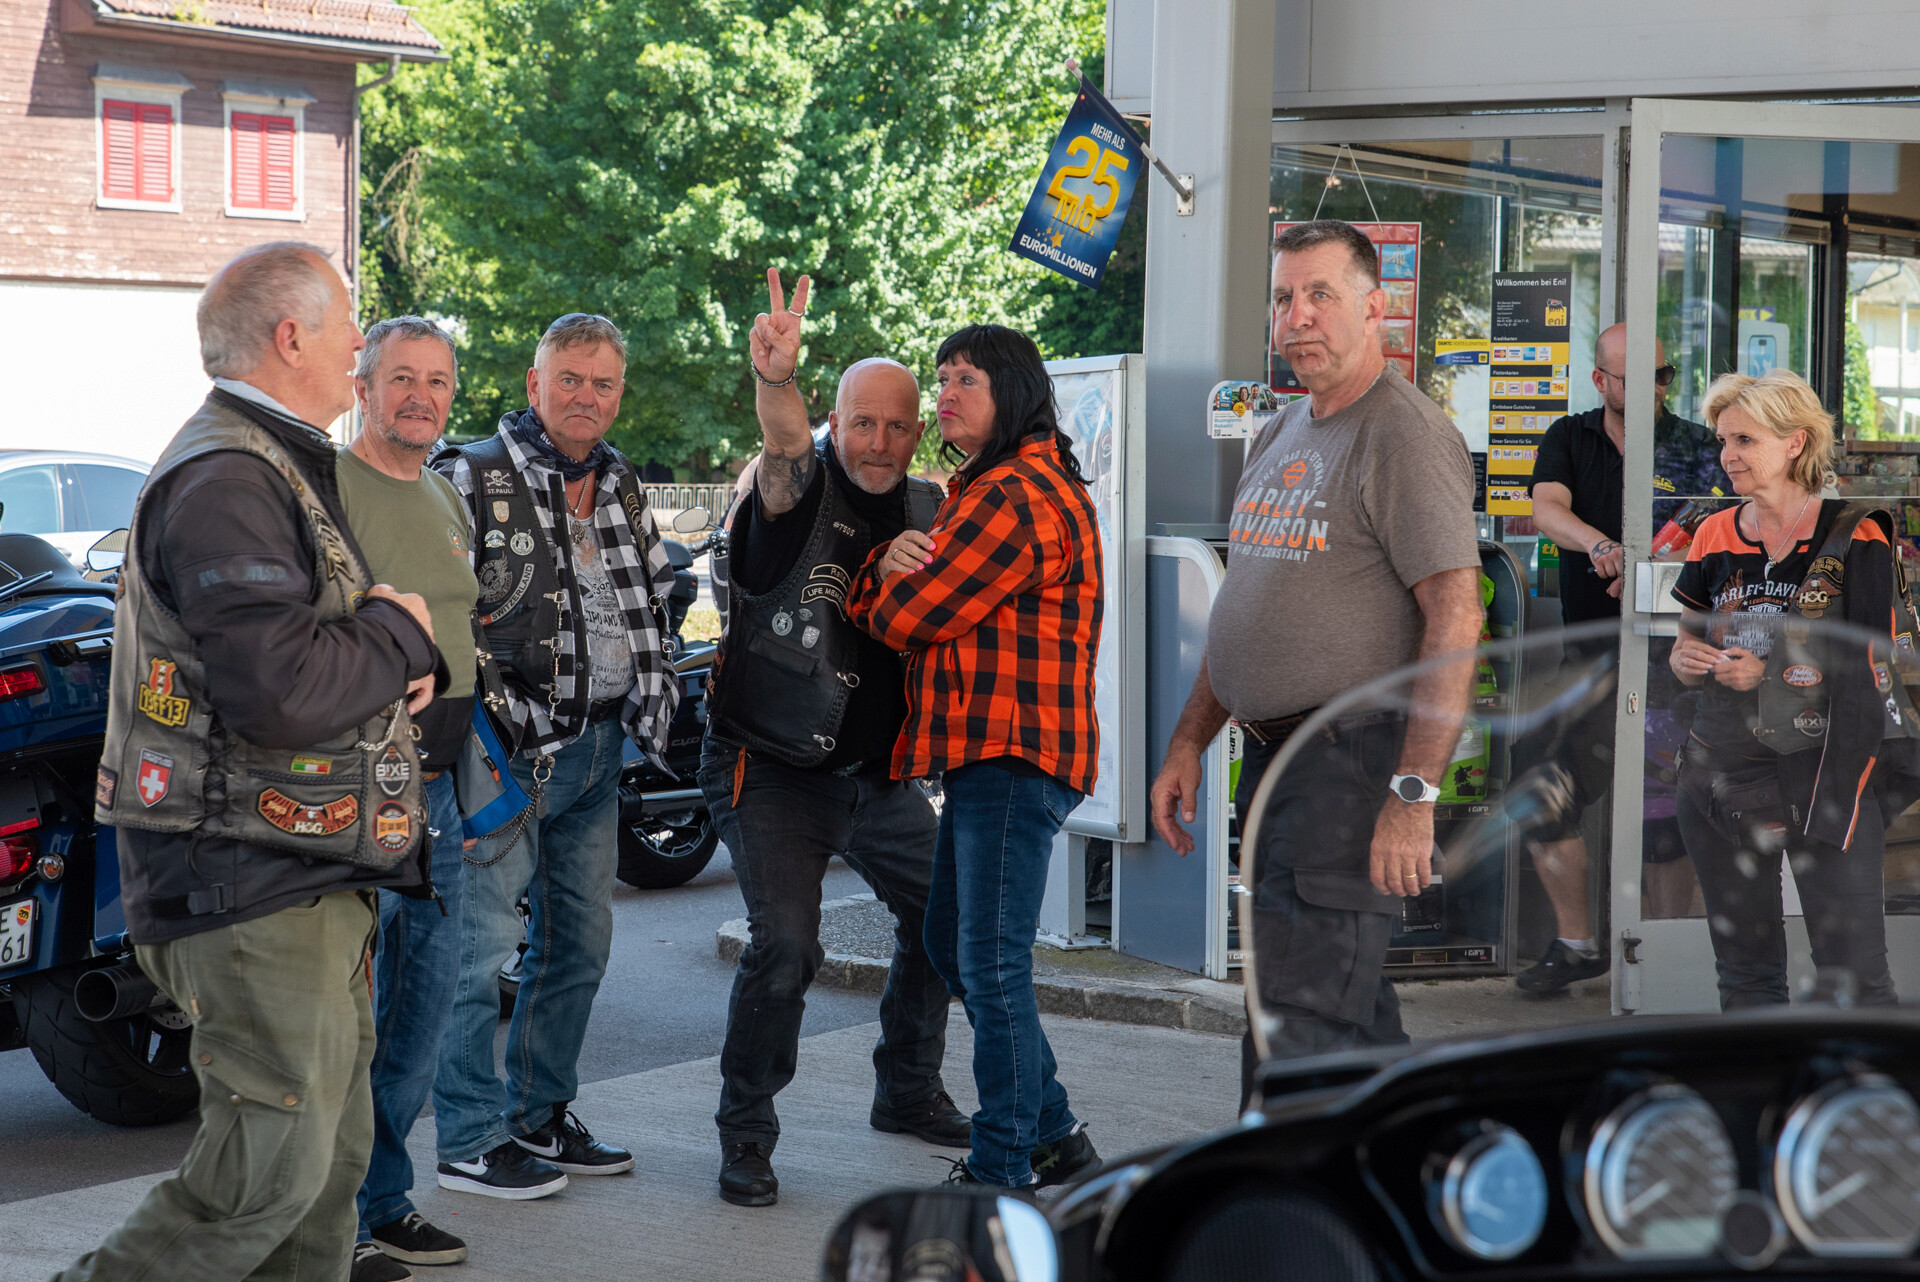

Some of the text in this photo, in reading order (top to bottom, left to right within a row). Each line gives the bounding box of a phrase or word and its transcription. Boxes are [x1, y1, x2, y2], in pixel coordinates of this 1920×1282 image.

[1091, 122, 1126, 150] MEHR ALS
[1047, 135, 1129, 218] 25
[1019, 234, 1098, 279] EUROMILLIONEN
[1495, 277, 1567, 287] Willkommen bei Eni!
[1548, 314, 1564, 326] eni
[1277, 397, 1289, 406] EU
[833, 521, 855, 537] #7505
[492, 565, 533, 620] SWITZERLAND
[807, 587, 823, 597] LIFE
[1712, 580, 1799, 612] HARLEY-DAVI
[1799, 591, 1828, 603] HOG
[1751, 604, 1778, 613] MOTOR
[294, 821, 323, 834] HOG
[2, 933, 26, 963] 61
